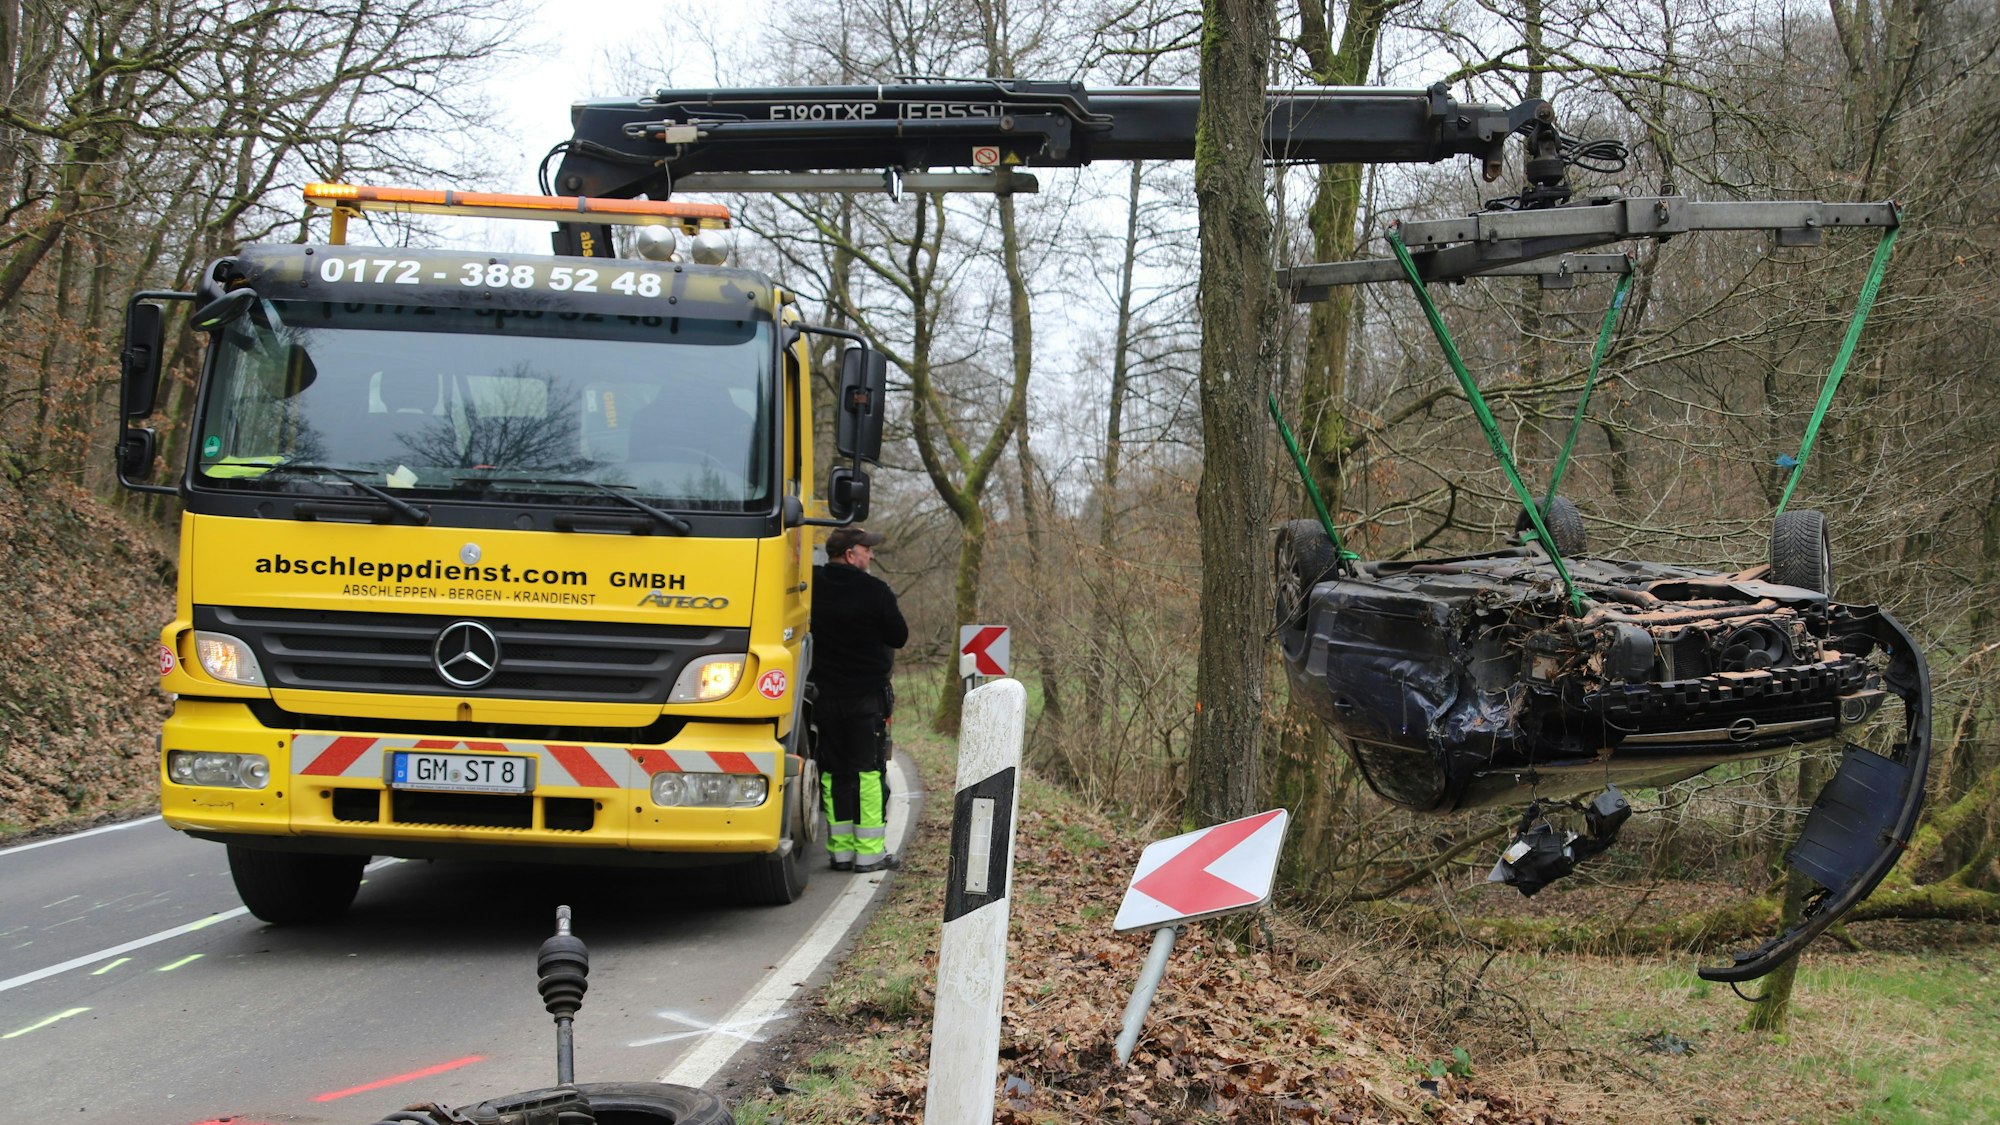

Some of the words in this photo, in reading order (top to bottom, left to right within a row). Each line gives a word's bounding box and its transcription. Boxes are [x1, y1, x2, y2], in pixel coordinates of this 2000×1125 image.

[769, 103, 877, 121] F190TXP
[907, 103, 996, 120] FASSI
[320, 258, 421, 284] 0172
[433, 271, 447, 279] -
[459, 262, 535, 289] 388
[548, 267, 599, 293] 52
[610, 272, 662, 298] 48
[255, 554, 587, 586] abschleppdienst.com
[609, 571, 686, 590] GMBH
[342, 584, 437, 599] ABSCHLEPPEN
[449, 588, 502, 601] BERGEN
[513, 590, 596, 606] KRANDIENST
[417, 757, 448, 781] GM
[464, 760, 495, 782] ST
[502, 761, 515, 783] 8
